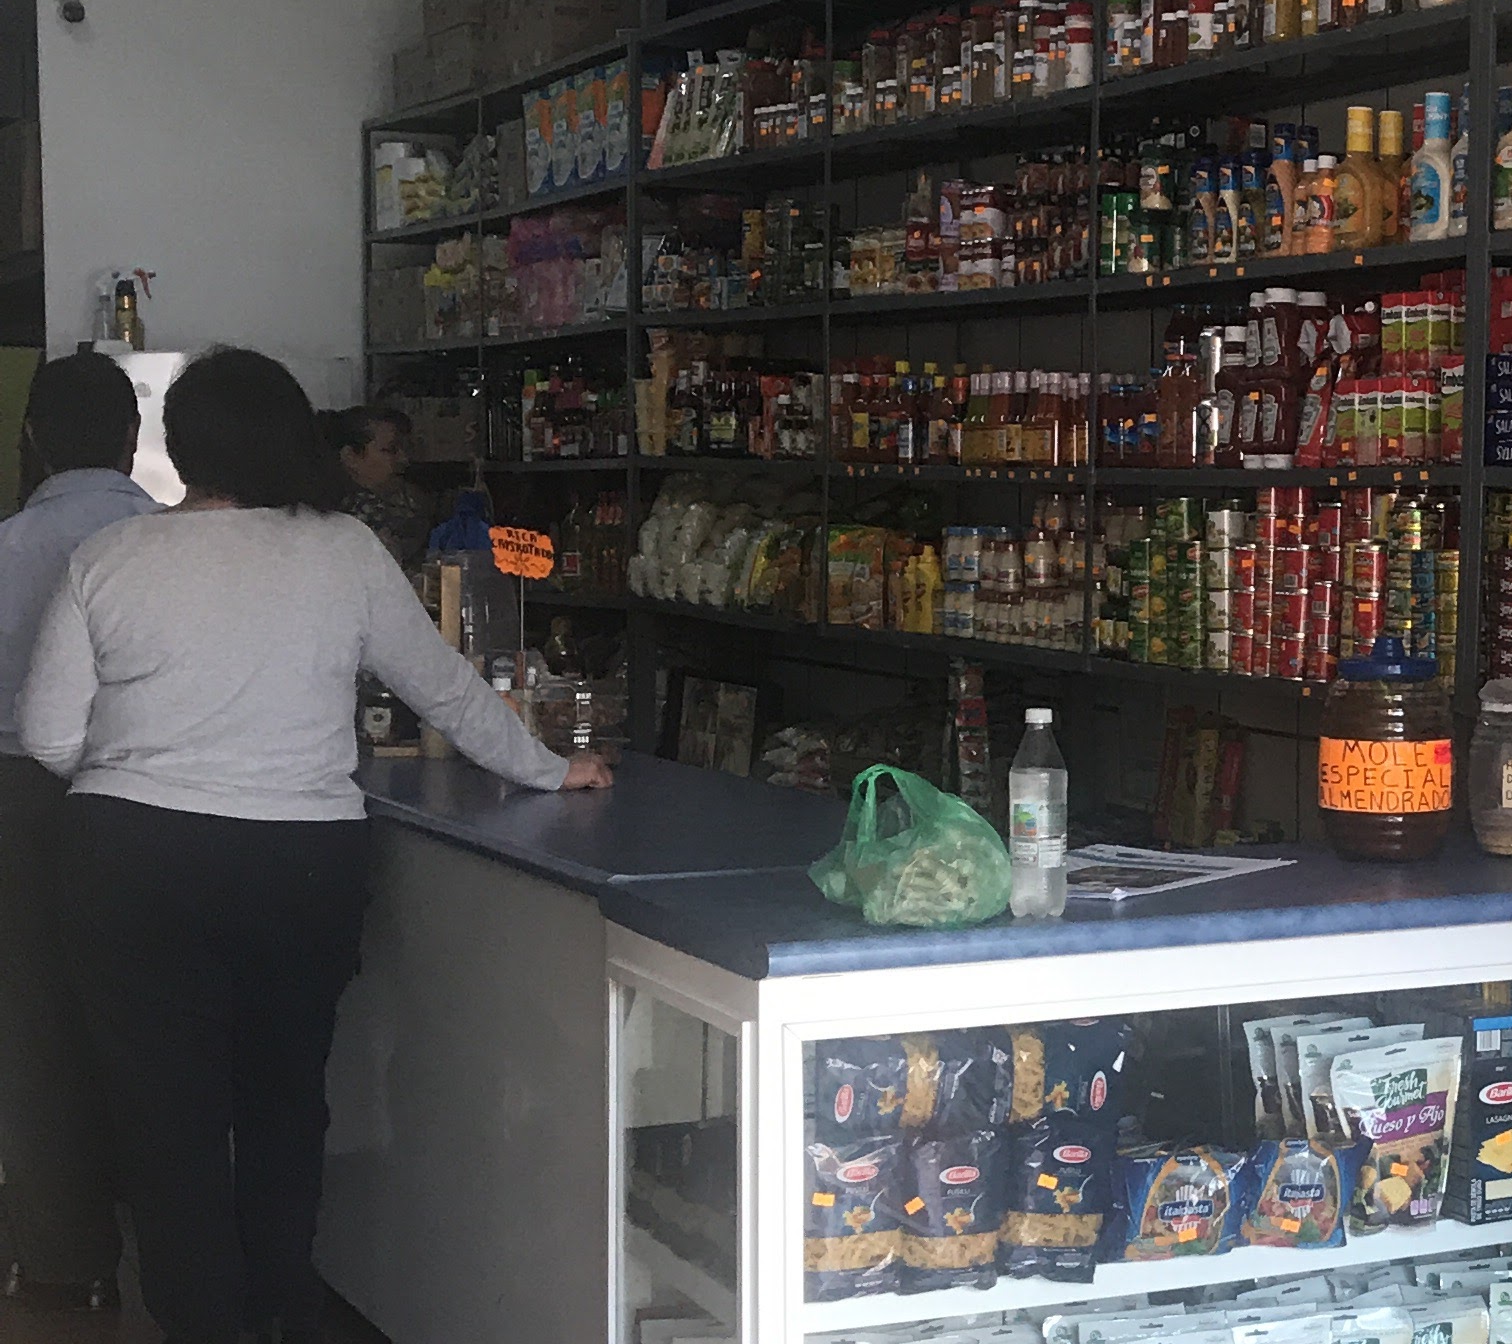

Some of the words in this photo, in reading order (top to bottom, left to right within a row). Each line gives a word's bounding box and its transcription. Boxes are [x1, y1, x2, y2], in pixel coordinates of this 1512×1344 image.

[1342, 741, 1428, 767] MOLE
[1320, 763, 1449, 789] ESPECIAL
[1320, 790, 1449, 812] ALMENDRADO
[1404, 1114, 1415, 1133] y
[1419, 1105, 1445, 1126] Ajo
[1164, 1202, 1209, 1217] italpasta
